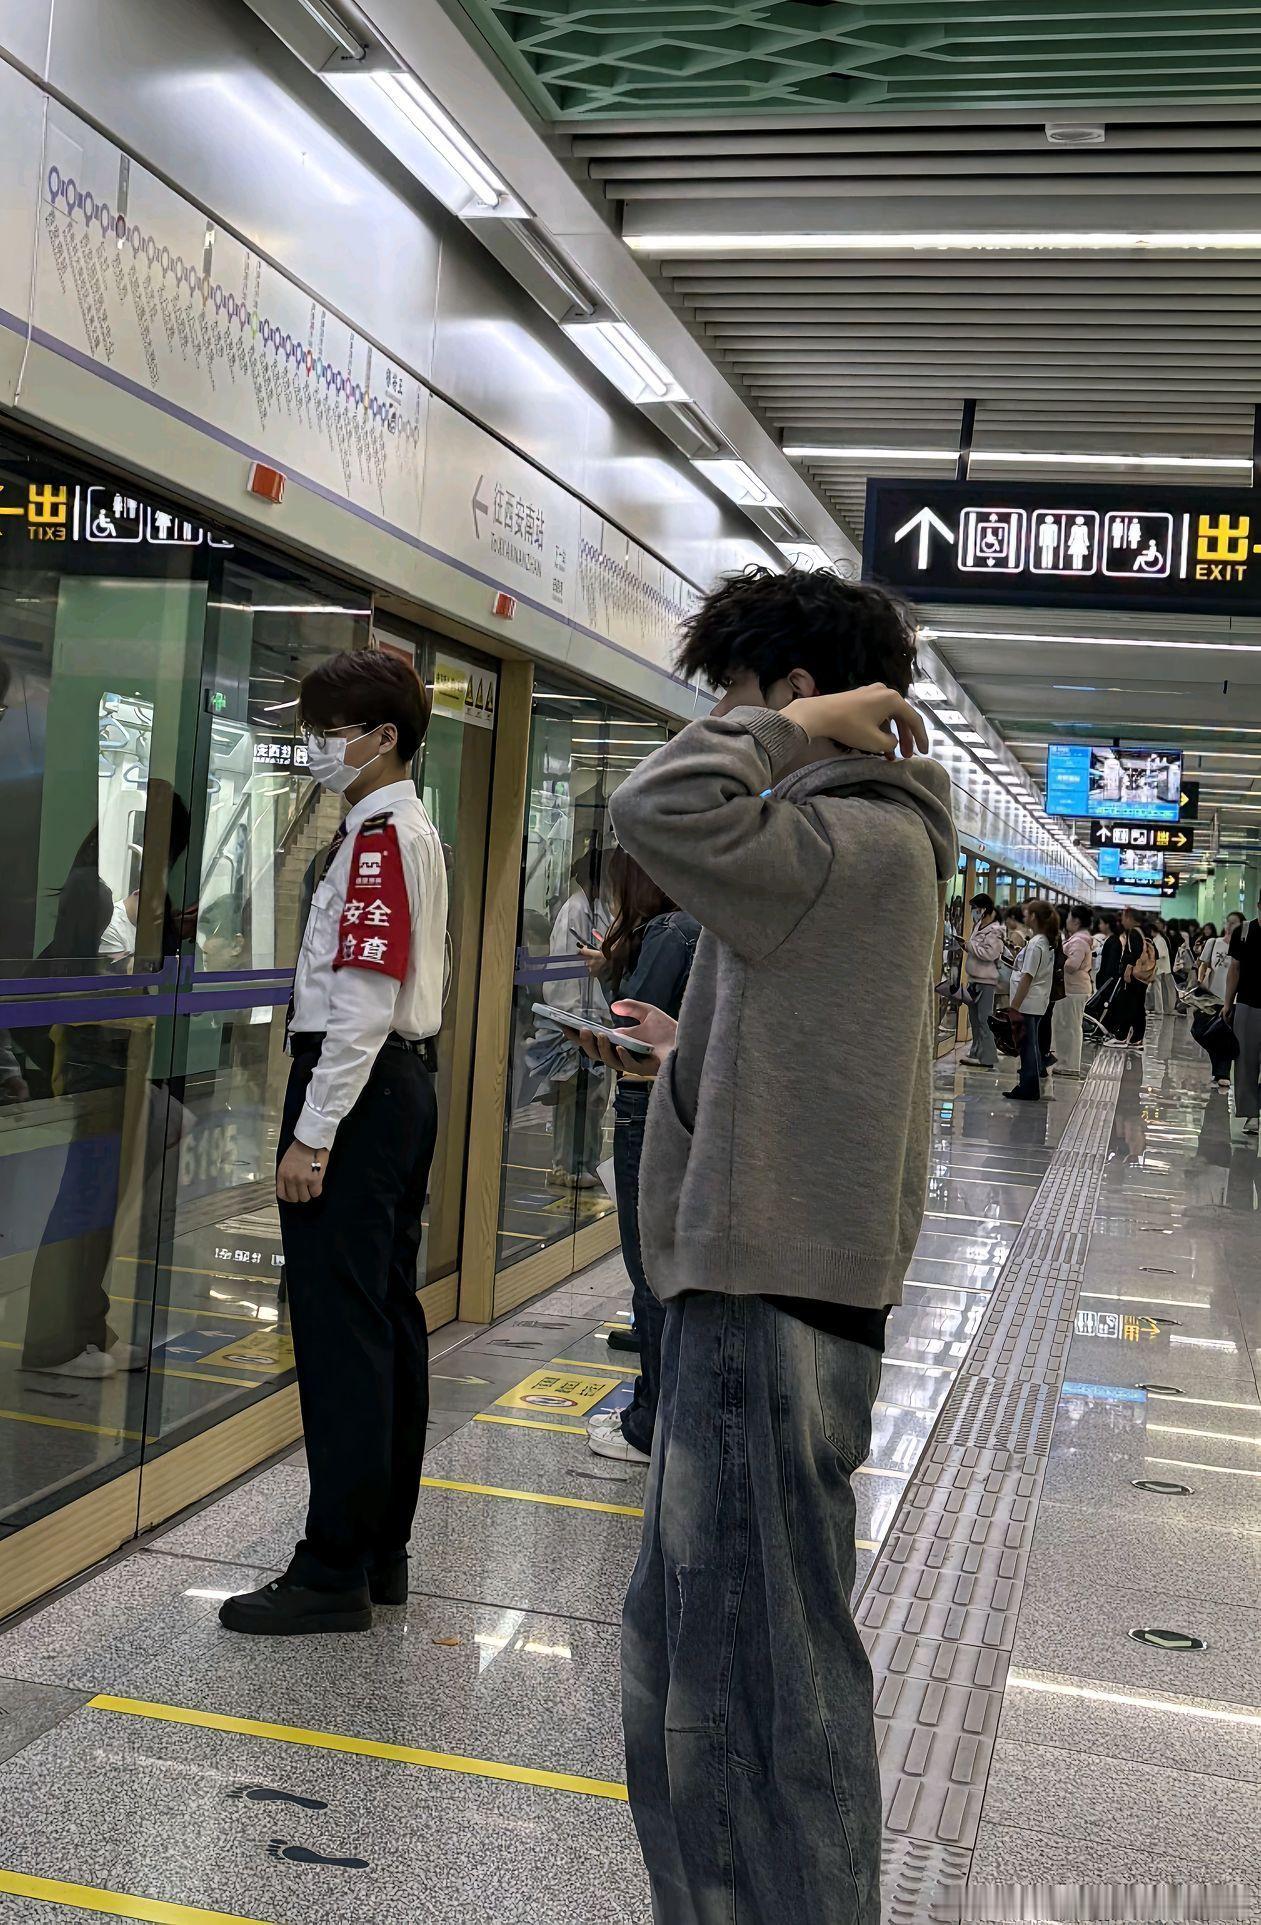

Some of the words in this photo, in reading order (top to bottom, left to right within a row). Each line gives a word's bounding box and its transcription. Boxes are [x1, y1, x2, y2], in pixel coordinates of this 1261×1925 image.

[1196, 515, 1250, 561] 出
[1196, 564, 1247, 581] EXIT
[343, 898, 392, 927] 安全
